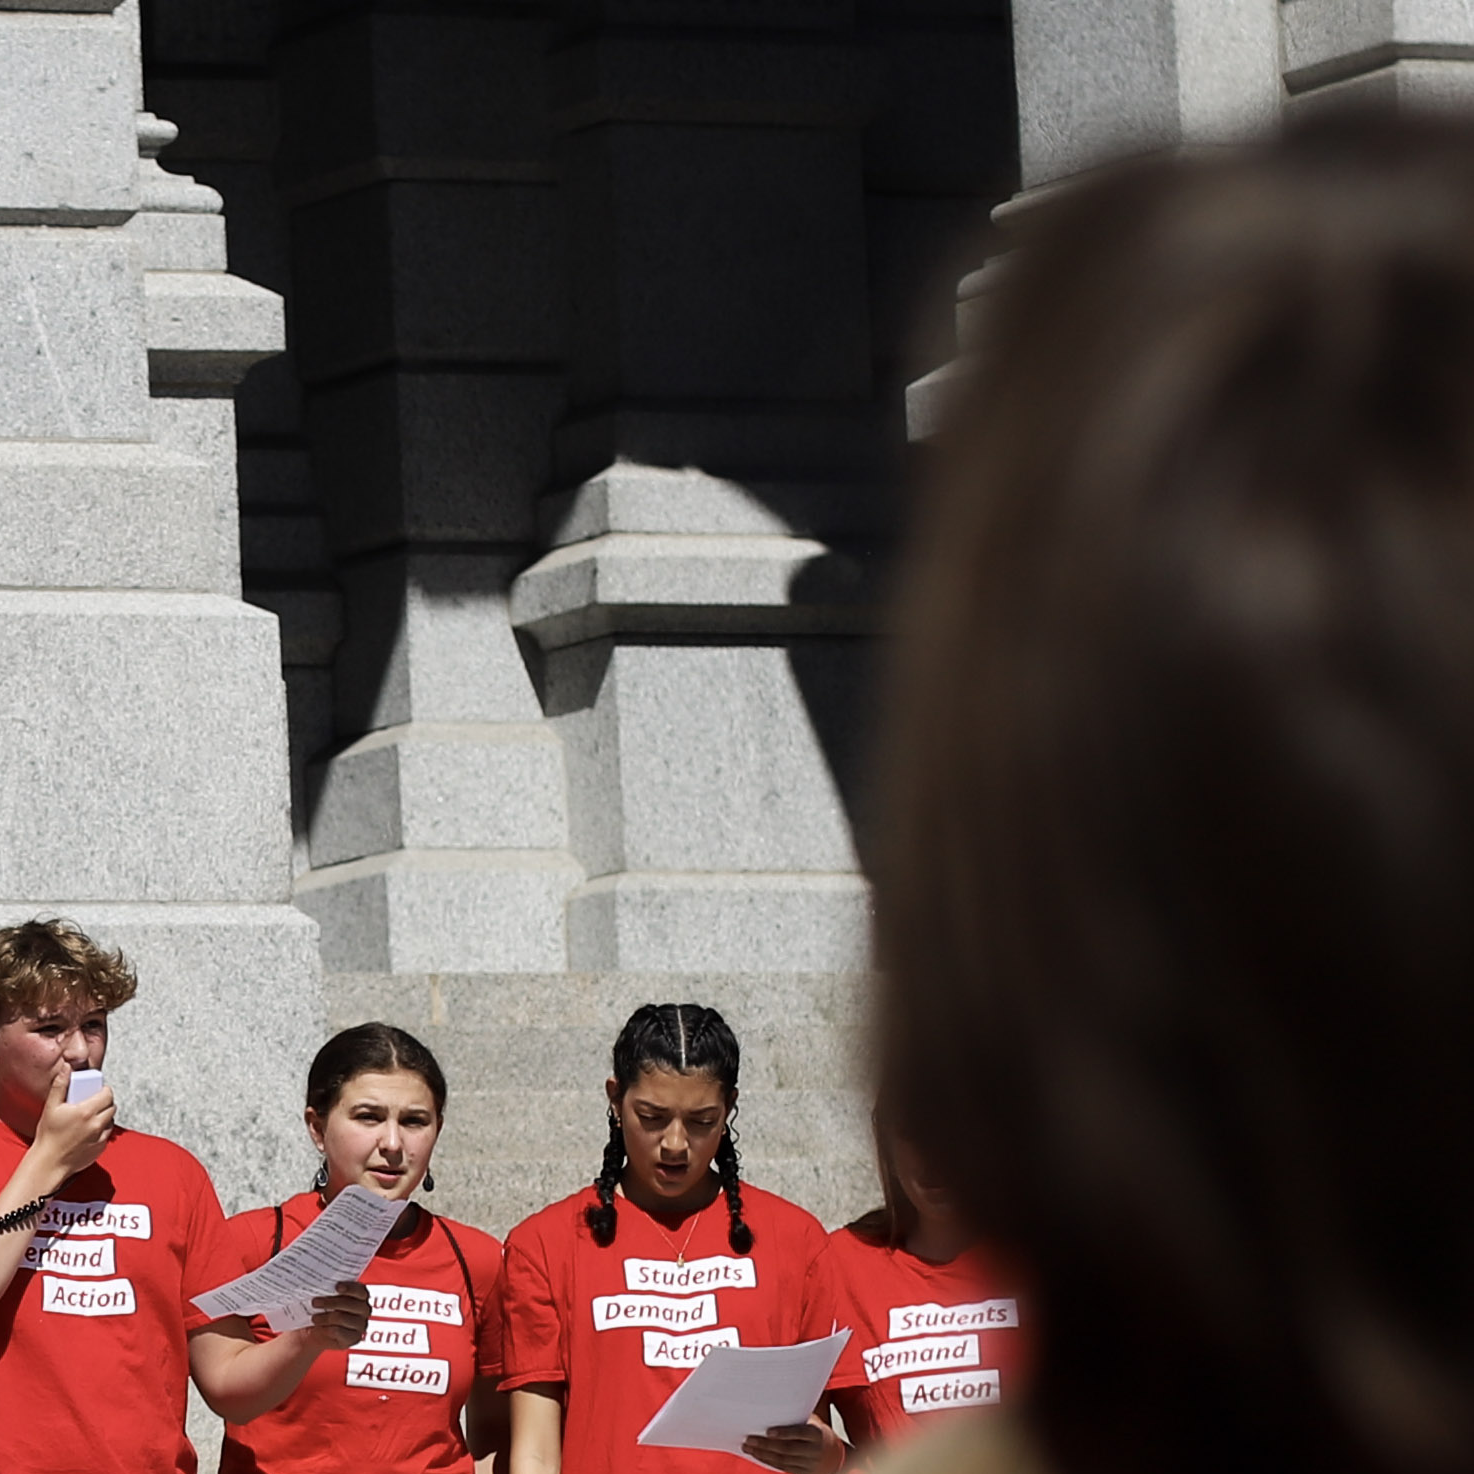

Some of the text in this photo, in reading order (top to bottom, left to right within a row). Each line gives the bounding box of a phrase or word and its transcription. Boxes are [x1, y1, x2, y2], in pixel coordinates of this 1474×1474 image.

[24, 1246, 104, 1268] emand
[637, 1264, 744, 1286] Students
[52, 1286, 127, 1308] Action
[372, 1293, 453, 1317] udents
[604, 1301, 704, 1323] Demand
[900, 1306, 1008, 1330] Students
[361, 1328, 417, 1345] and
[870, 1340, 969, 1374] Demand
[355, 1362, 442, 1386] Action
[911, 1379, 992, 1405] Action
